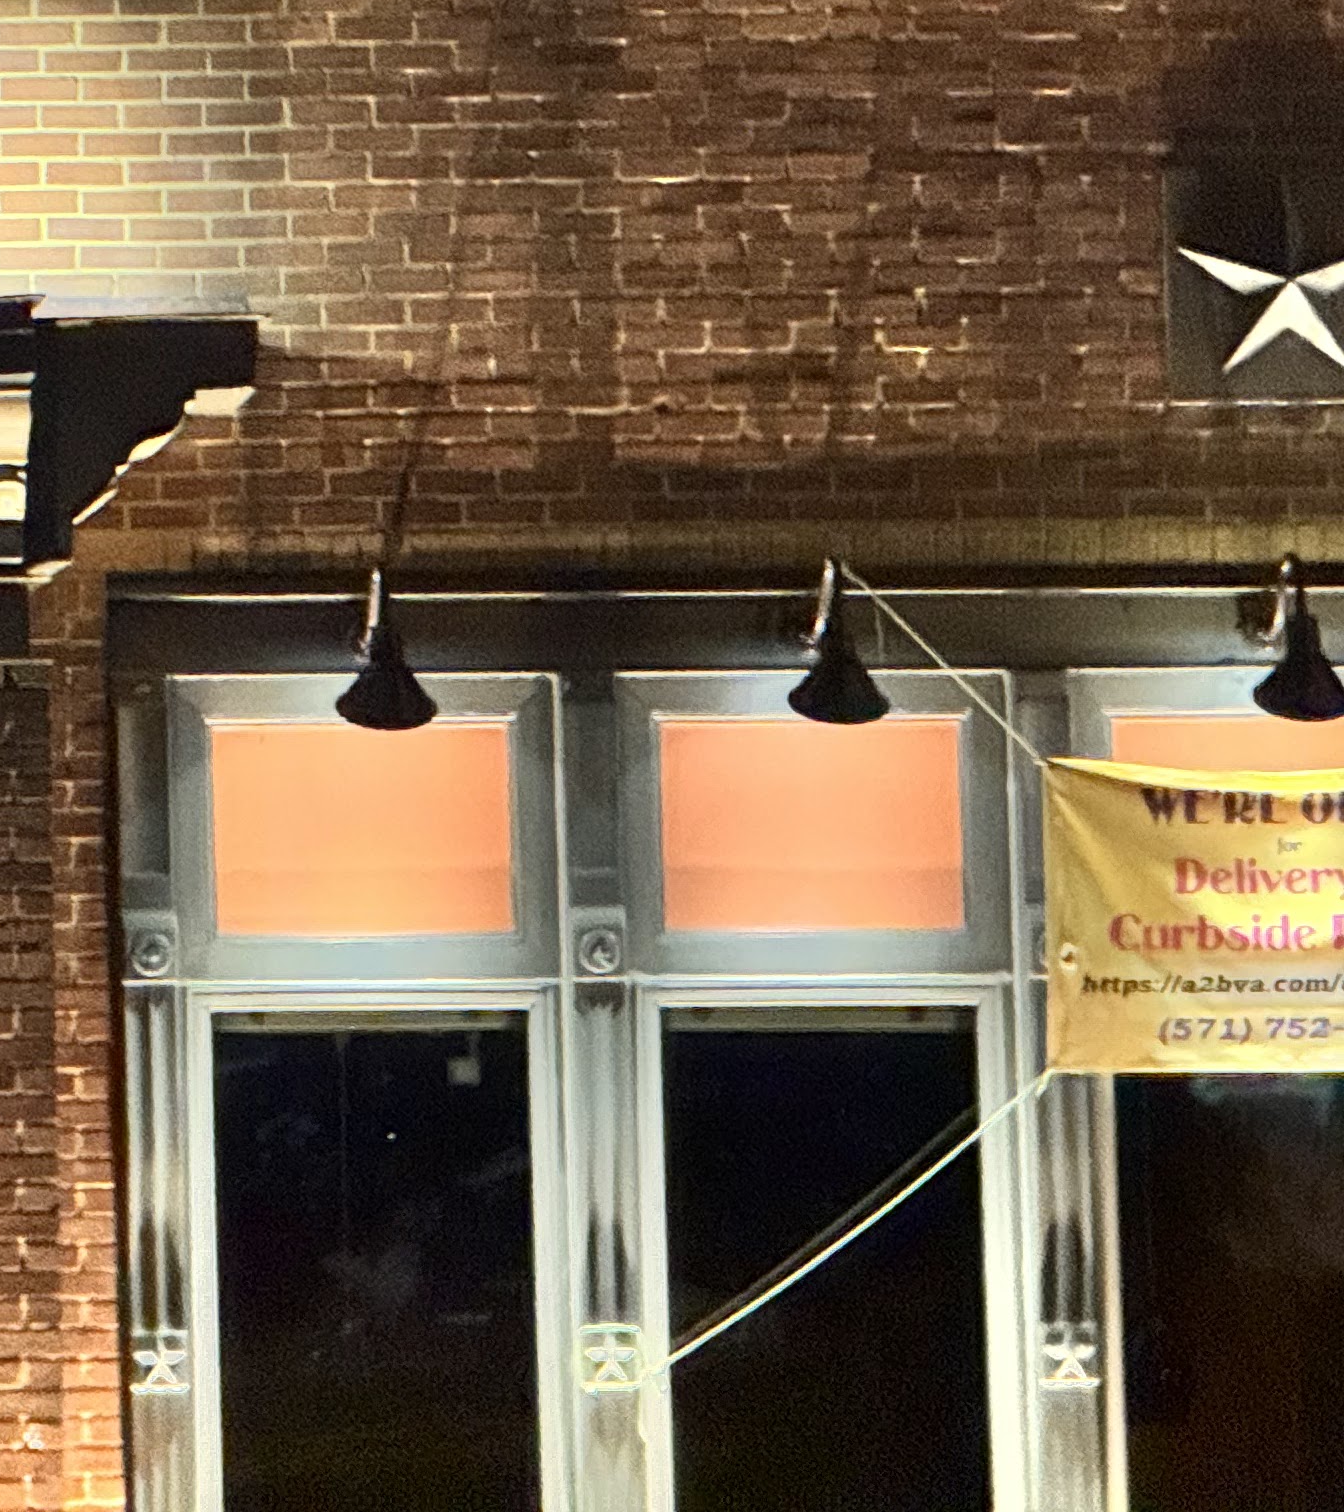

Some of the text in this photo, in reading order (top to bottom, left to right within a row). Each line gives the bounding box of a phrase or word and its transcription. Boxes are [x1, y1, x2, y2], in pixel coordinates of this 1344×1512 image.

[1109, 913, 1316, 951] Curbside
[1082, 972, 1344, 998] https://a2bva.com/
[1158, 1016, 1254, 1046] (571)
